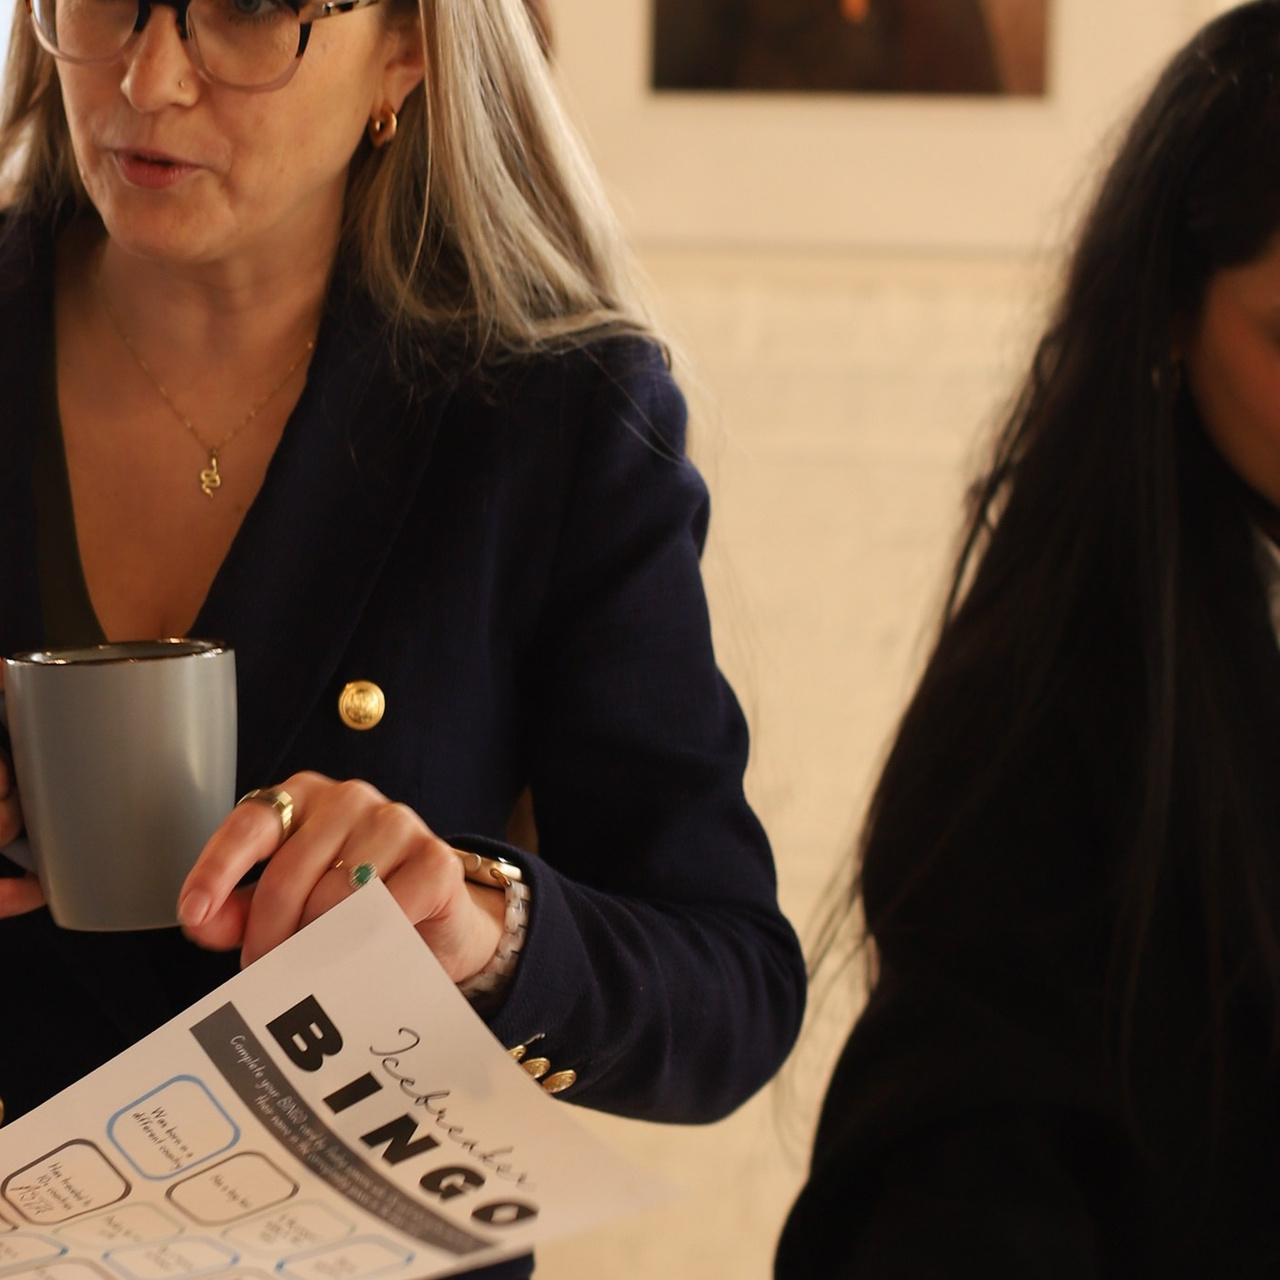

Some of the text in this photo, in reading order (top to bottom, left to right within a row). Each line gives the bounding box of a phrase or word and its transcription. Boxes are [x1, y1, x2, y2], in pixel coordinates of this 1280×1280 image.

[230, 1035, 266, 1078] Complete
[254, 1079, 280, 1098] your
[132, 1112, 166, 1144] different
[151, 1106, 168, 1129] Was
[165, 1126, 183, 1145] born
[266, 994, 539, 1232] BINGO
